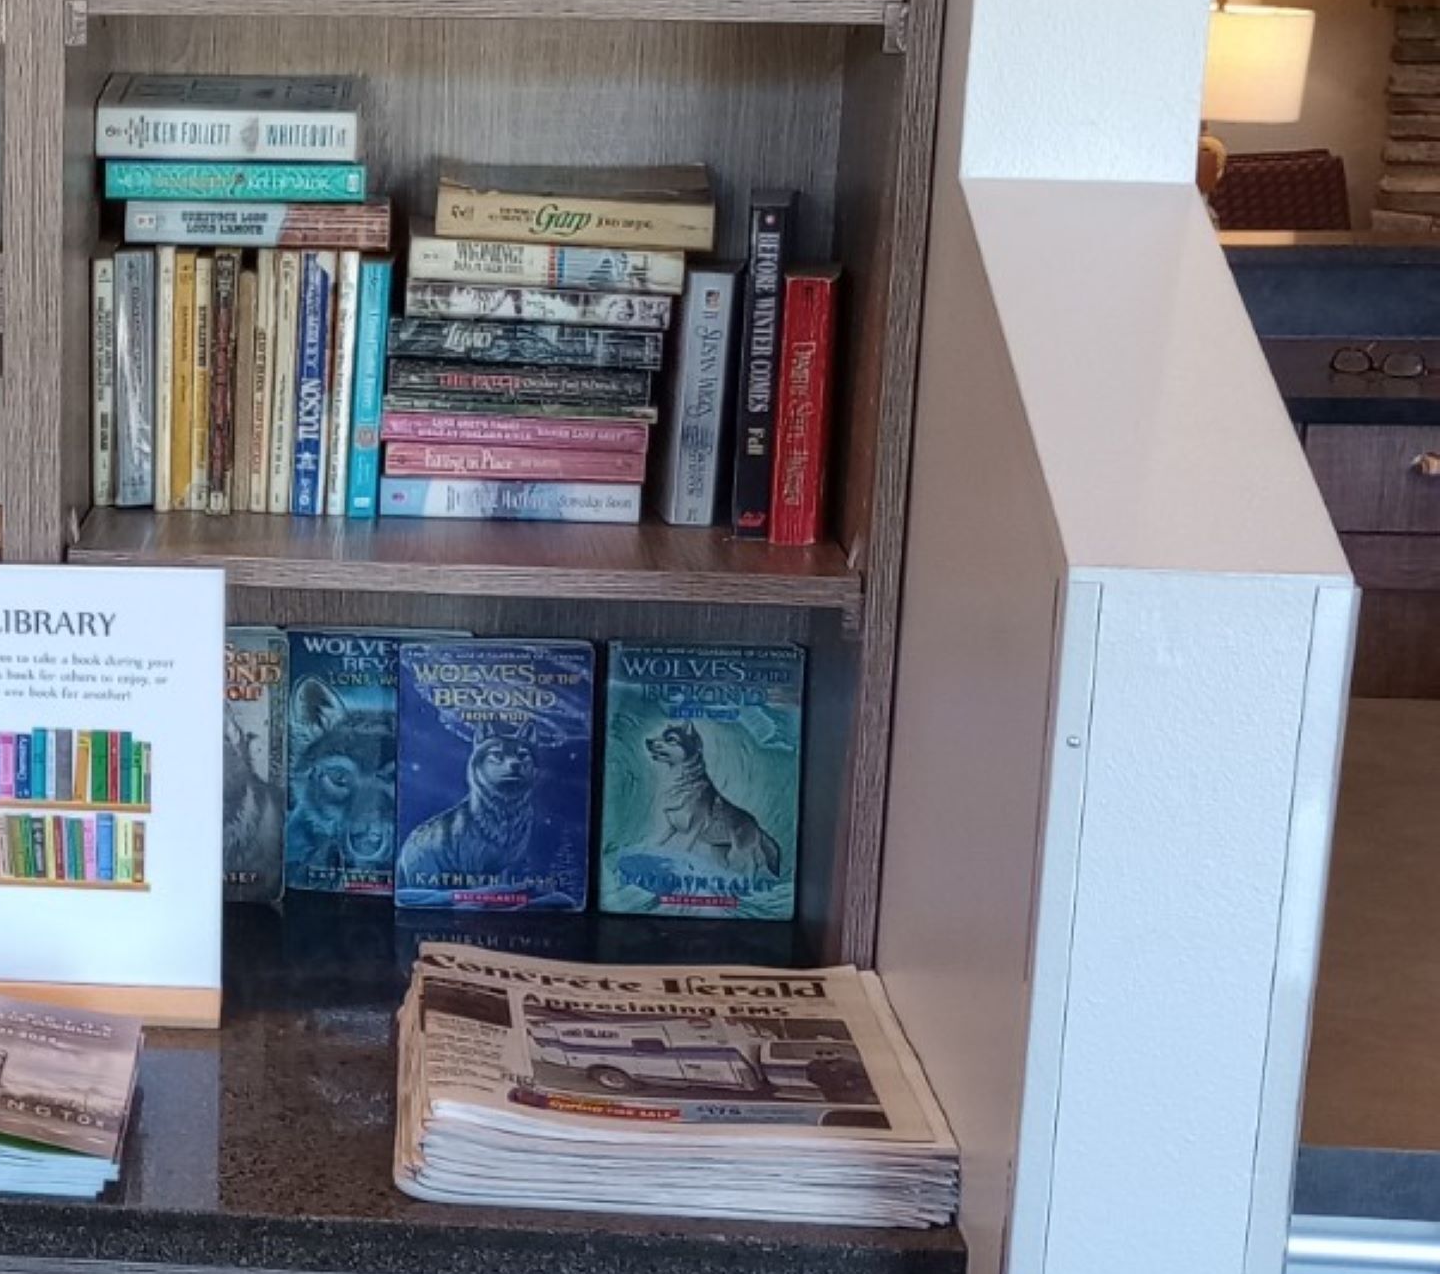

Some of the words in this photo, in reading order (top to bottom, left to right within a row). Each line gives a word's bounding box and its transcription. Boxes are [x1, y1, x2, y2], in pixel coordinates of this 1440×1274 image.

[153, 123, 176, 145] KEN
[180, 122, 231, 145] FOLLETT
[266, 124, 334, 148] WHITEOUT
[533, 202, 592, 236] Garp
[754, 231, 781, 292] BEFORE
[751, 297, 776, 356] WINTER
[747, 359, 773, 413] COMES
[296, 375, 322, 442] TUCSON
[16, 653, 29, 663] to
[32, 653, 57, 664] take
[71, 653, 101, 666] book
[104, 655, 143, 669] during
[147, 659, 174, 671] your
[412, 663, 536, 686] WOLVES
[621, 655, 746, 683] WOLVES
[6, 669, 35, 681] book
[38, 670, 56, 681] for
[60, 671, 97, 683] others
[100, 673, 113, 684] to
[117, 674, 151, 687] enjoy,
[154, 676, 167, 685] or
[3, 689, 24, 698] one
[28, 687, 58, 699] book
[61, 687, 79, 699] for
[82, 688, 131, 702] another!
[432, 687, 557, 710] BEYOND
[415, 871, 501, 888] KATHRYN
[421, 954, 643, 995] Concrete
[660, 974, 827, 999] Herald
[522, 992, 716, 1018] Appreciating
[728, 1004, 790, 1018] EMS
